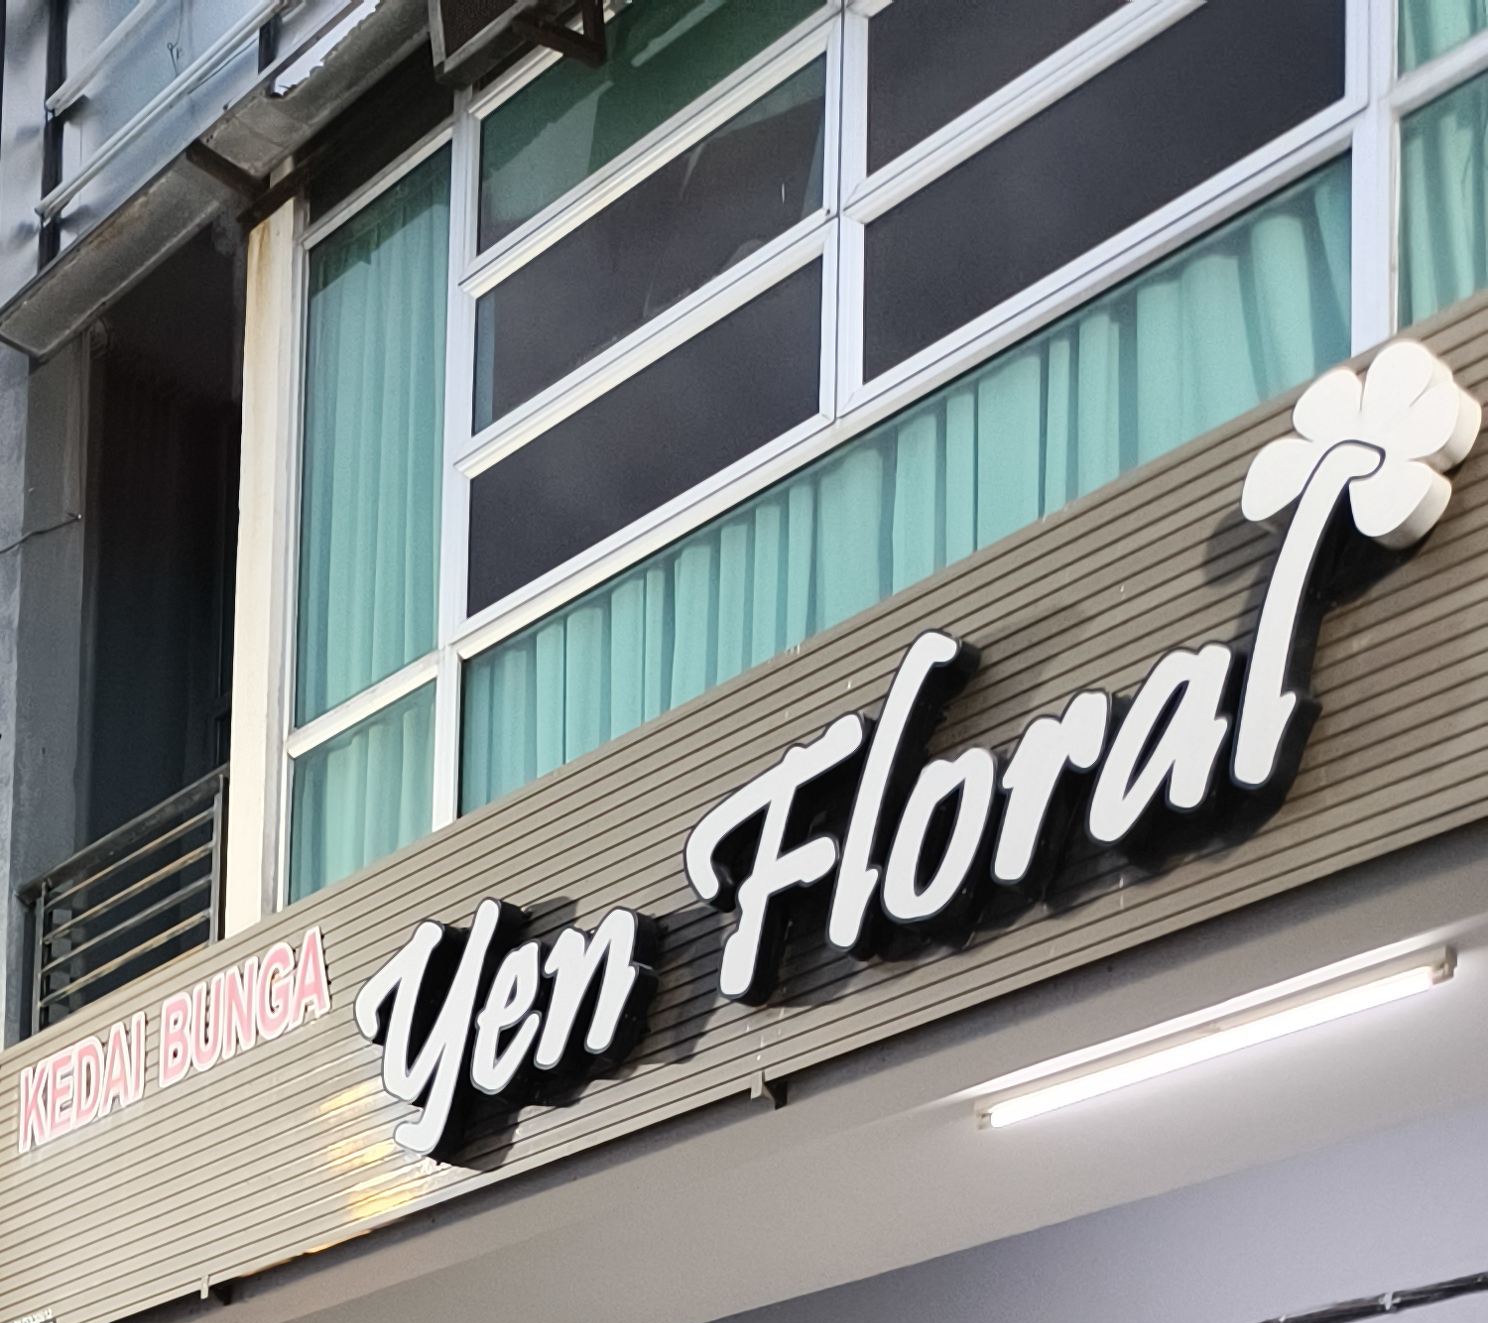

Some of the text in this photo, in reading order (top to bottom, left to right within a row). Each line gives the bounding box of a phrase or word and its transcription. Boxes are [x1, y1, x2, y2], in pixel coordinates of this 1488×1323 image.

[684, 440, 1387, 1000] Floral
[18, 925, 332, 1153] KEDAI BUNGA
